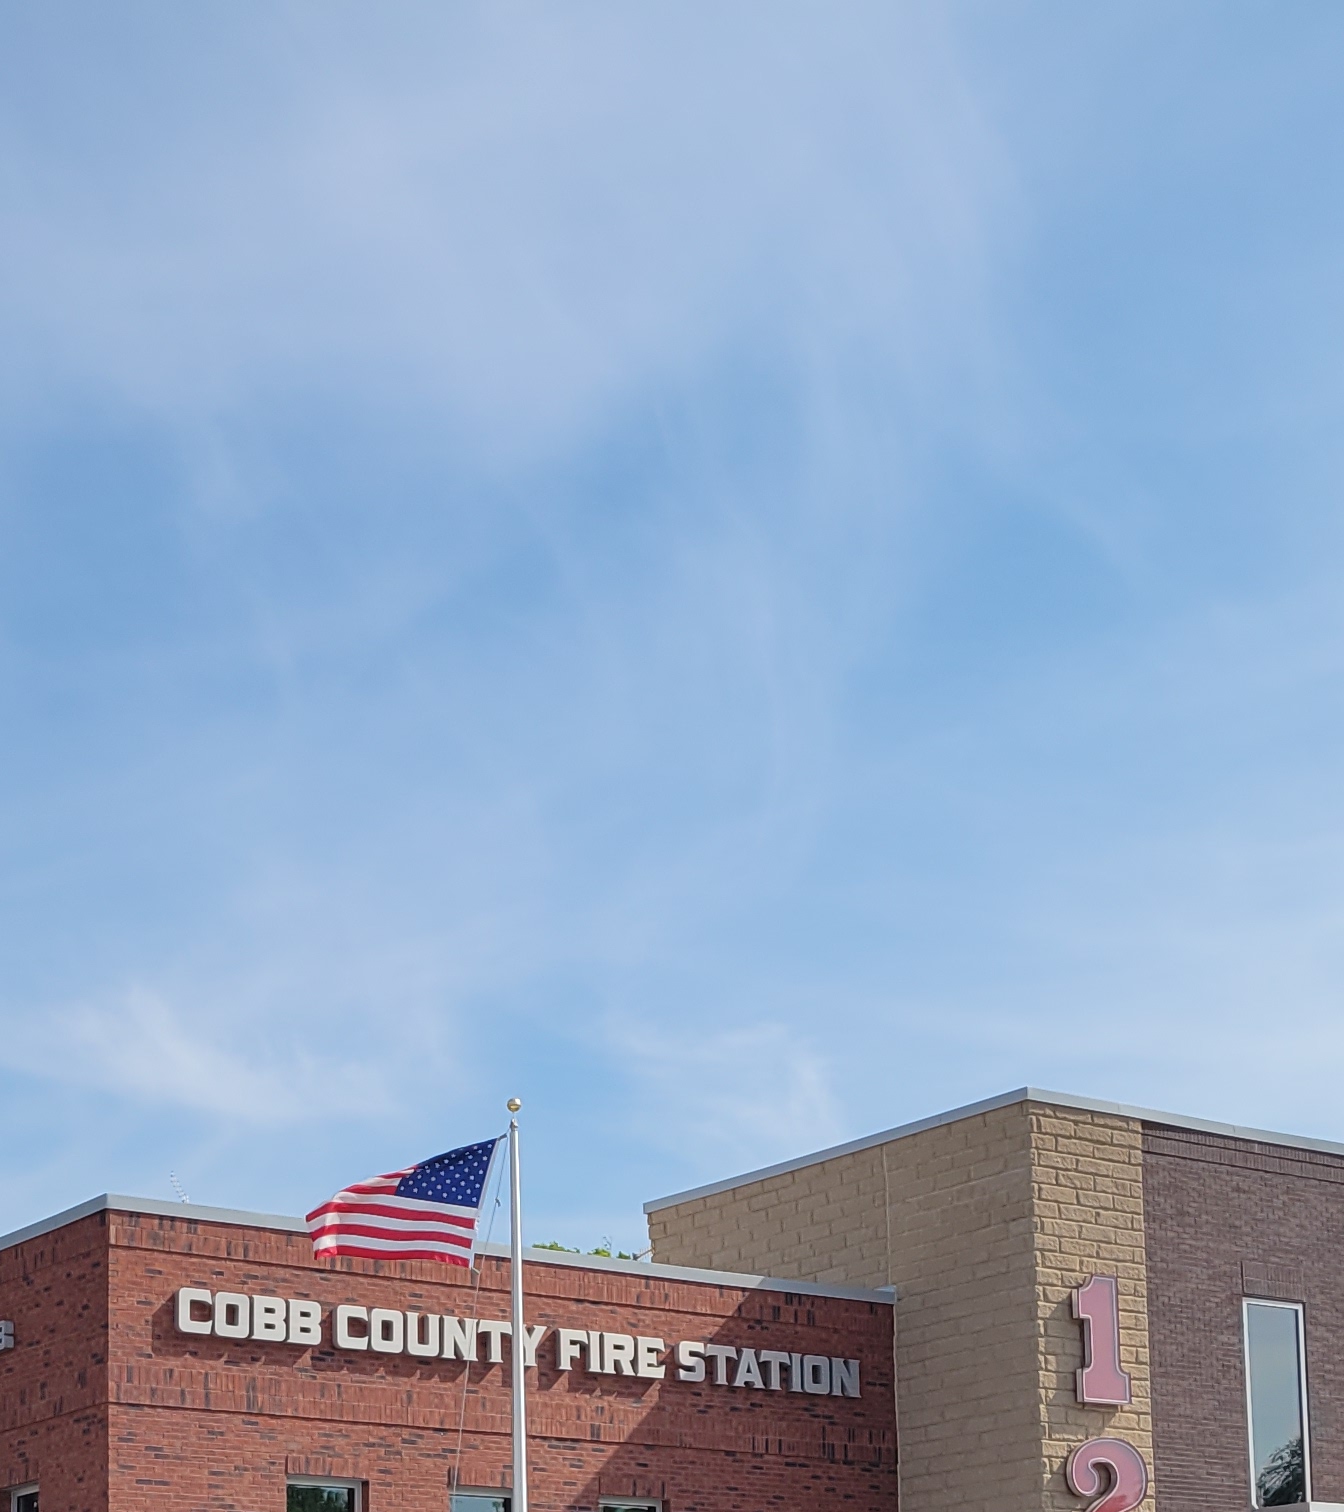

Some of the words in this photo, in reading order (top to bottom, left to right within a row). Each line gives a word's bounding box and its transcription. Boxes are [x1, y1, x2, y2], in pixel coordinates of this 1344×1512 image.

[175, 1286, 323, 1346] COBB
[332, 1303, 548, 1367] COUNTY
[557, 1327, 666, 1379] FIRE
[675, 1340, 862, 1398] STATION
